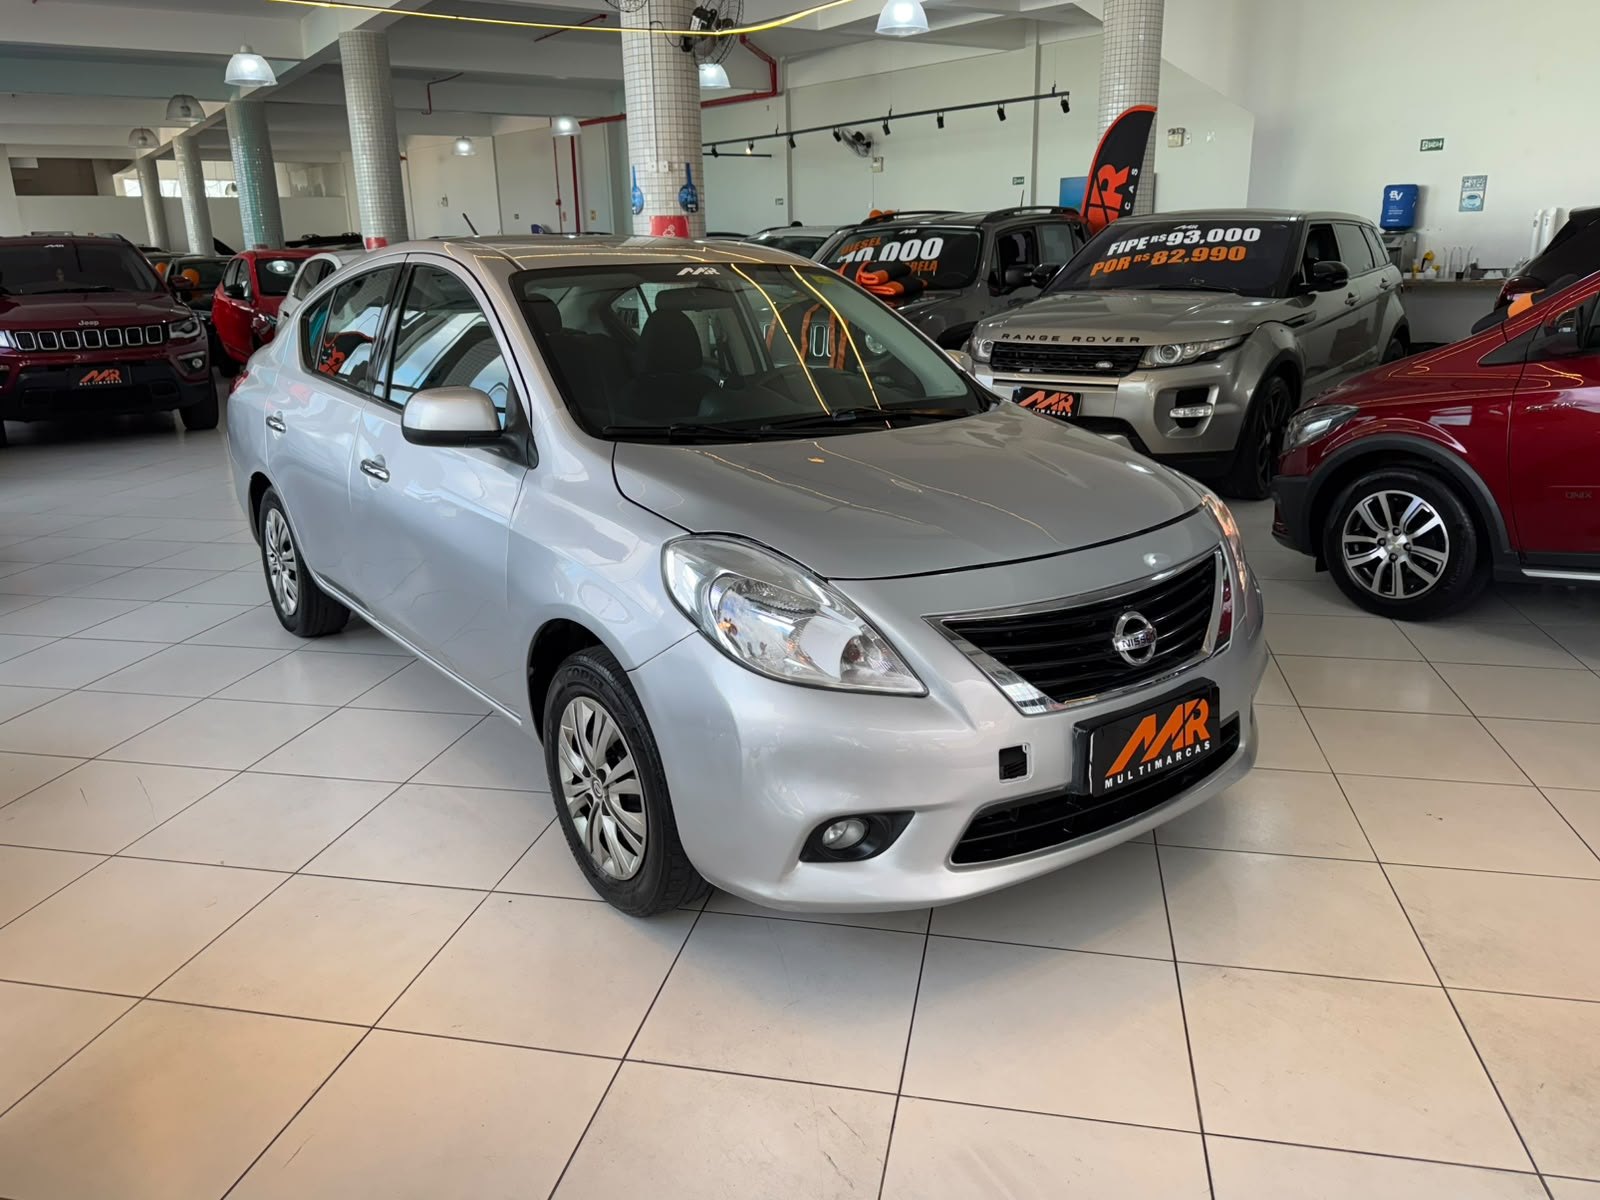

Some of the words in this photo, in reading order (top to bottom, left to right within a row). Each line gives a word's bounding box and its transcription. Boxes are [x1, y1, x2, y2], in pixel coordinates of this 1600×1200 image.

[1107, 236, 1149, 257] FIPE
[1089, 256, 1132, 277] POR
[78, 319, 100, 327] Jeep
[1001, 333, 1060, 342] RANGE
[1071, 336, 1141, 344] ROVER
[1104, 740, 1211, 790] MULTIMARCAS
